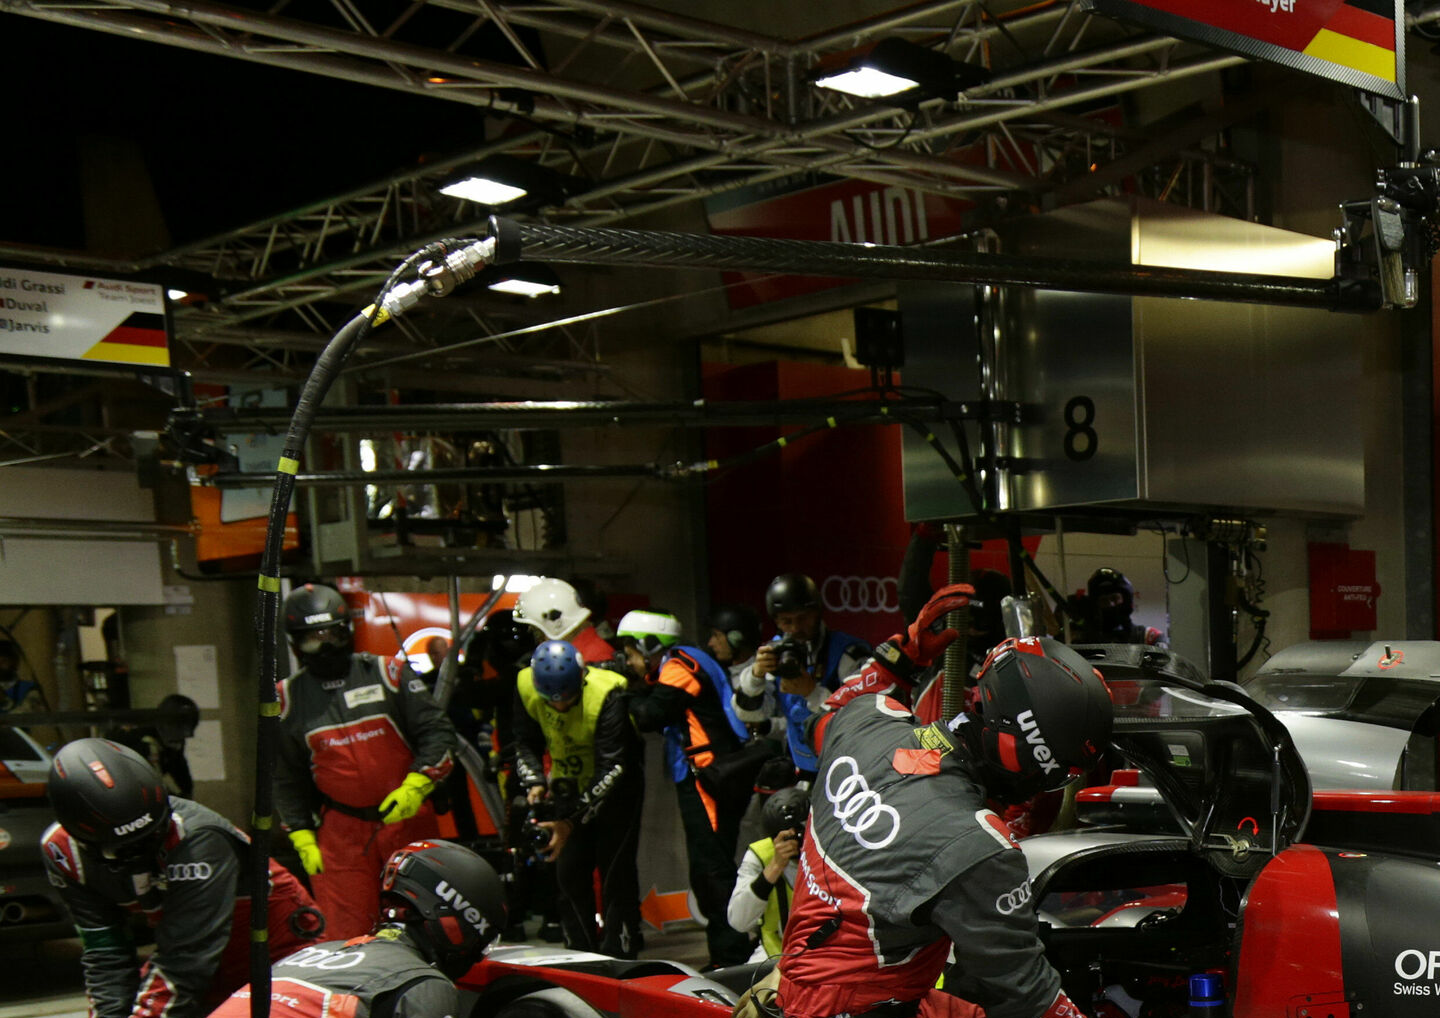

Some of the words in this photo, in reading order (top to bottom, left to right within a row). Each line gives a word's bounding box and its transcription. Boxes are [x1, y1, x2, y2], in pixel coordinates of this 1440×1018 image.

[830, 187, 928, 246] AUDI
[21, 279, 65, 294] Grassi
[6, 298, 48, 312] Duval
[8, 319, 50, 334] Jarvis
[1064, 396, 1098, 462] 8
[356, 728, 386, 743] Sport
[1016, 709, 1061, 774] uvex
[114, 812, 153, 837] uvex
[806, 875, 842, 911] Sport
[435, 880, 490, 936] uvex
[1393, 982, 1431, 996] Swiss
